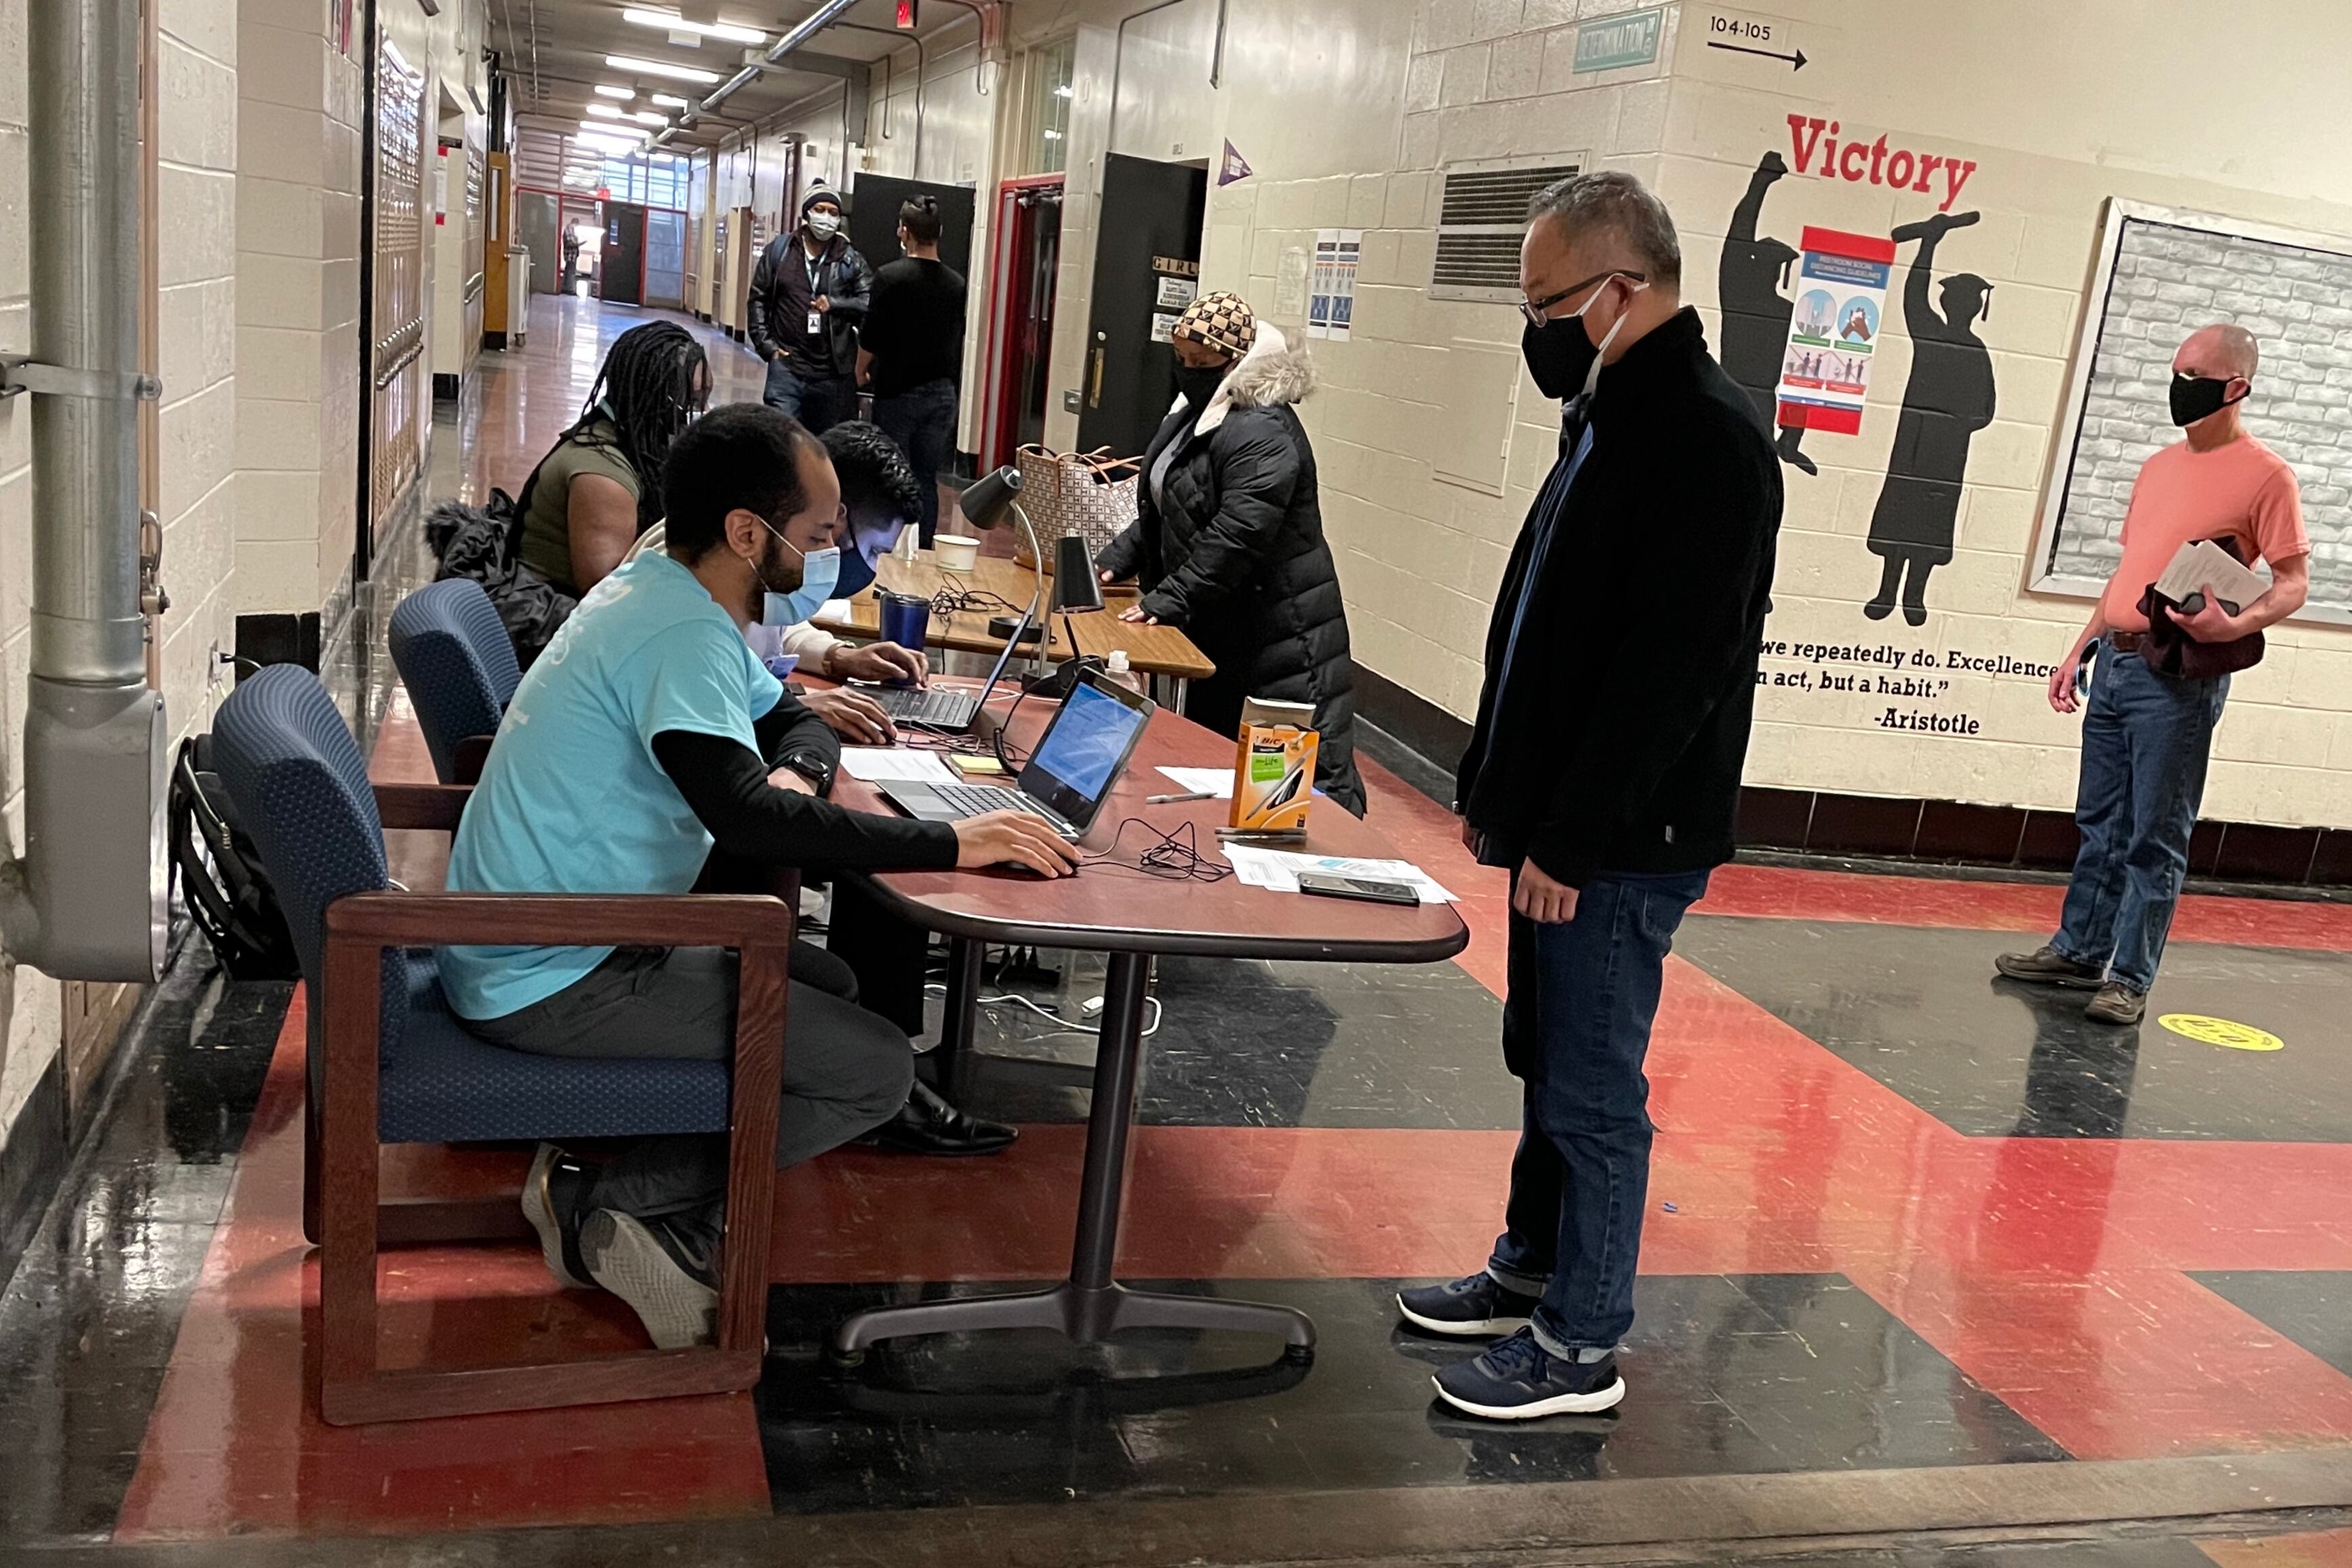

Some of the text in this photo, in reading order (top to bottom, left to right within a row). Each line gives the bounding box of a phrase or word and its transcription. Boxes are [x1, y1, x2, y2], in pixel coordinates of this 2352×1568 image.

[1577, 22, 1646, 61] DETERMINATION
[1710, 16, 1771, 41] 104-105
[1787, 113, 1977, 212] Victory
[1759, 641, 2059, 678] we repeatedly do. Excellence
[1774, 670, 1813, 692] act,
[1819, 670, 1855, 691] but
[1859, 678, 1870, 693] a
[1874, 708, 1980, 734] -Aristotle
[1261, 737, 1281, 745] BIC
